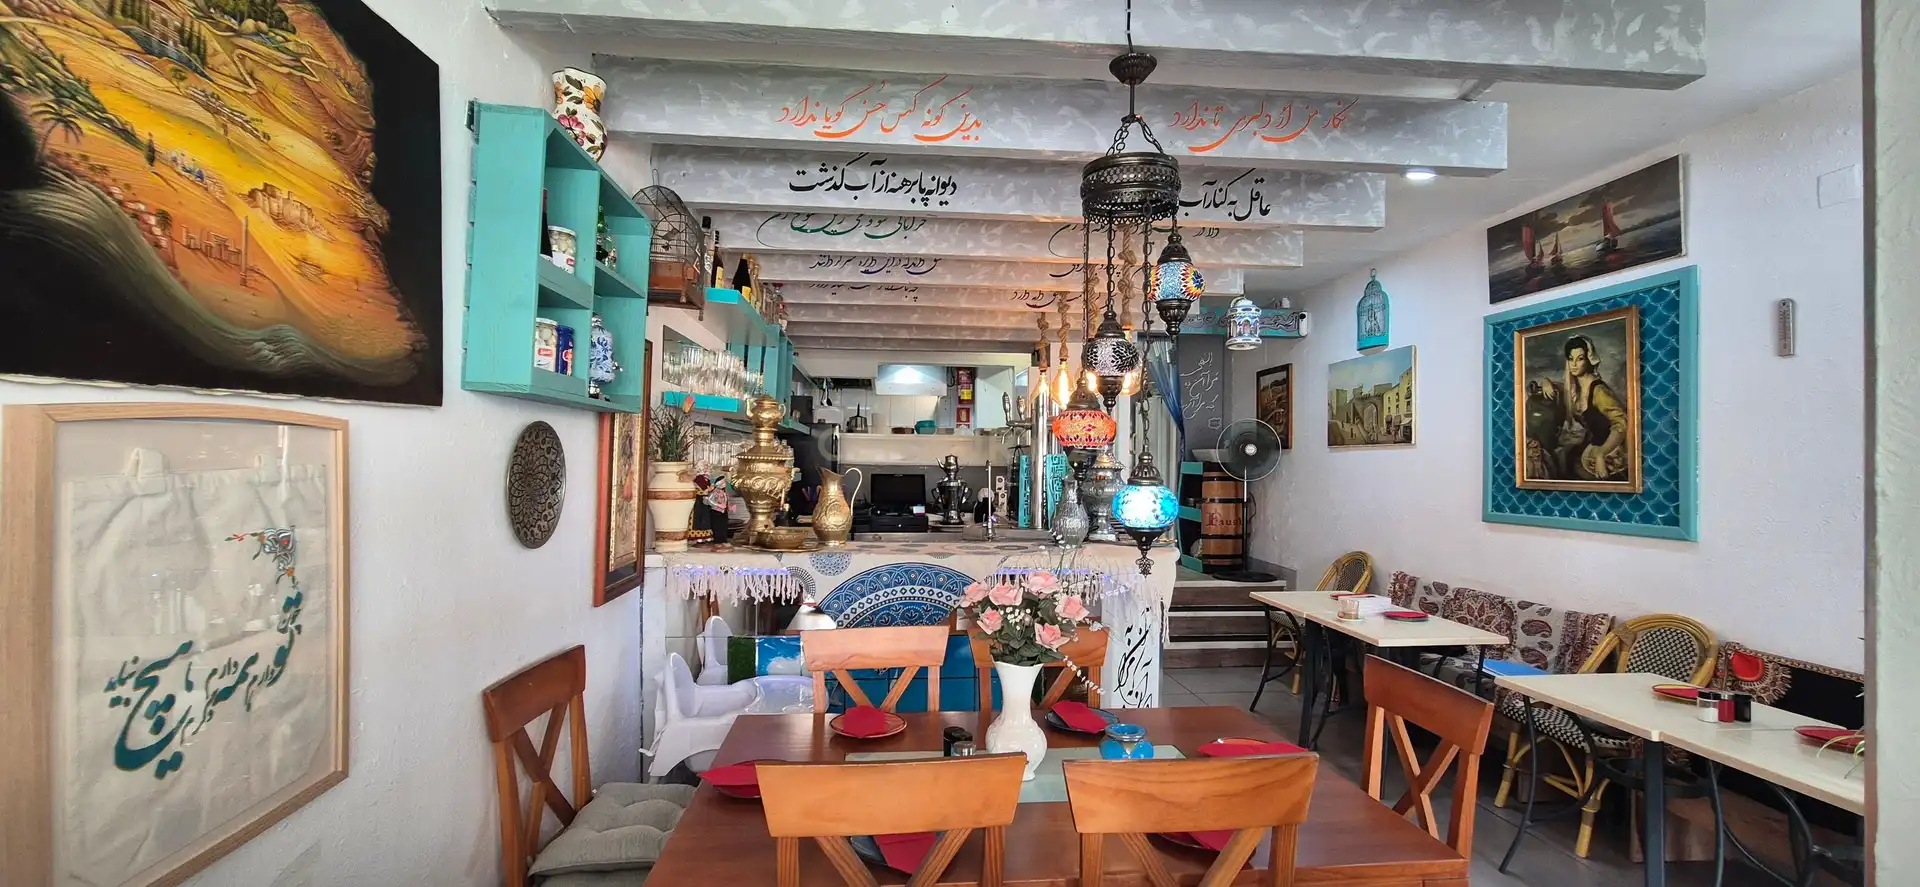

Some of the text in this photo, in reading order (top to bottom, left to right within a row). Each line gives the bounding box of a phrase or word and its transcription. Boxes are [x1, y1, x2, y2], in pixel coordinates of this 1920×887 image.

[773, 95, 820, 126] ندارد
[1168, 100, 1209, 130] ندارد
[789, 152, 869, 191] گذشت
[850, 158, 887, 200] آب
[1178, 167, 1271, 221] عاقل به کنار آب
